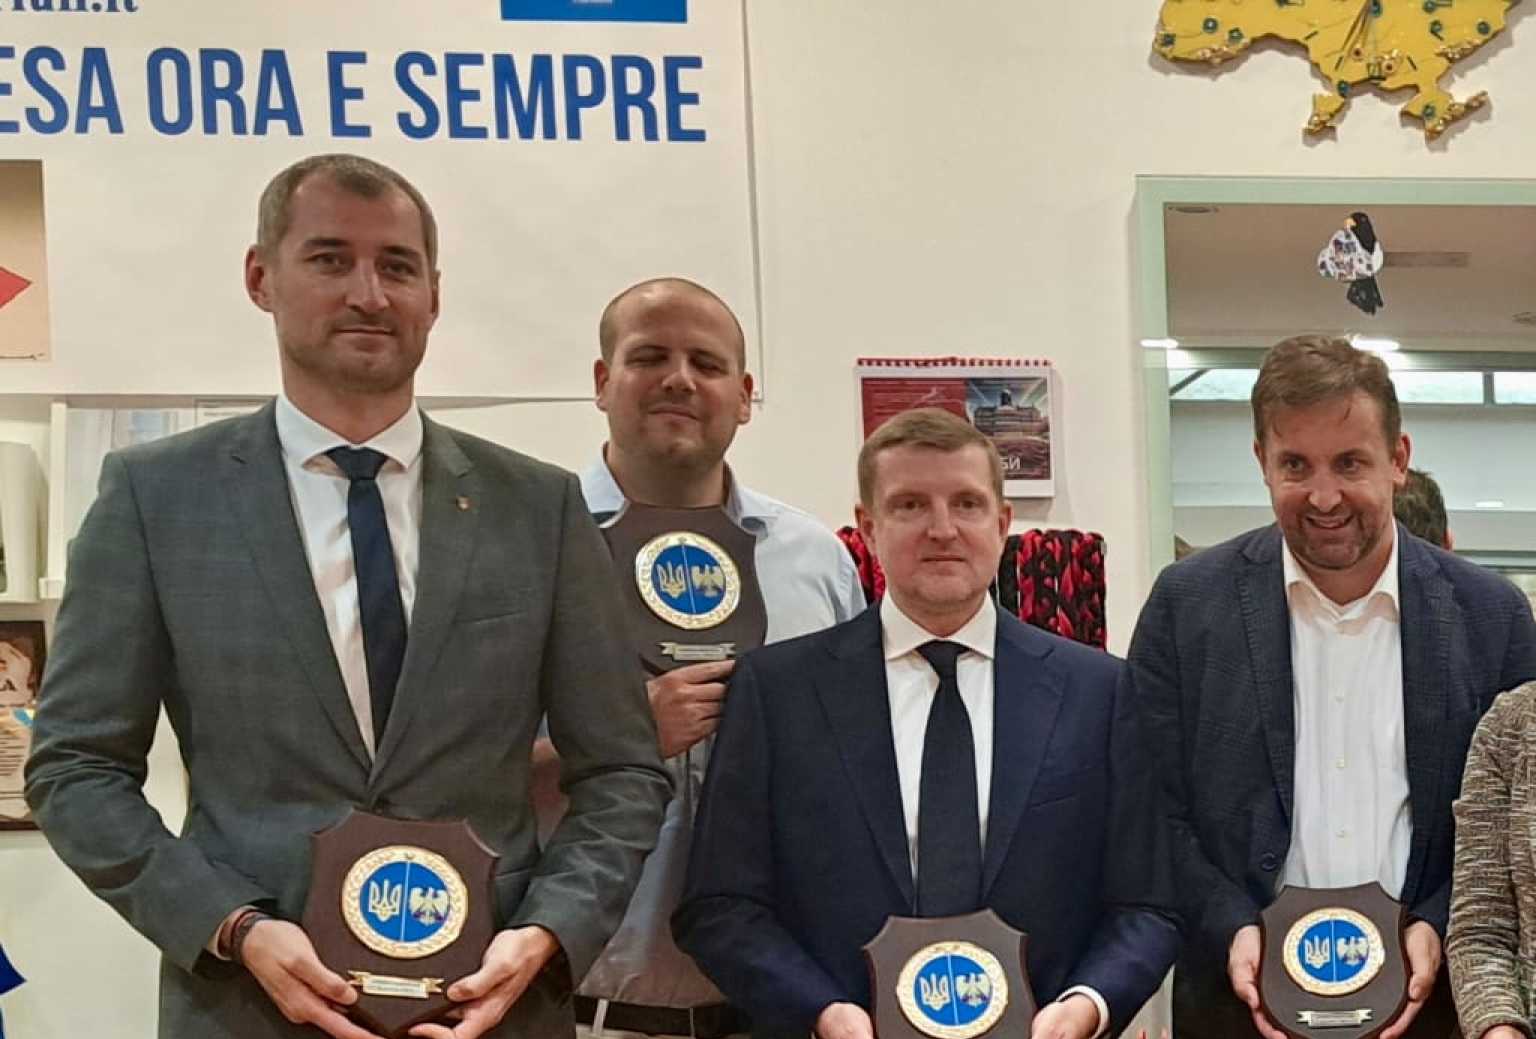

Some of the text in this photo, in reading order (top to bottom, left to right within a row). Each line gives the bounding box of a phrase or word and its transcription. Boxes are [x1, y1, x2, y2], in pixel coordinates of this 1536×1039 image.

[147, 47, 304, 136] ORA
[327, 51, 373, 137] E
[396, 51, 706, 142] SEMPRE
